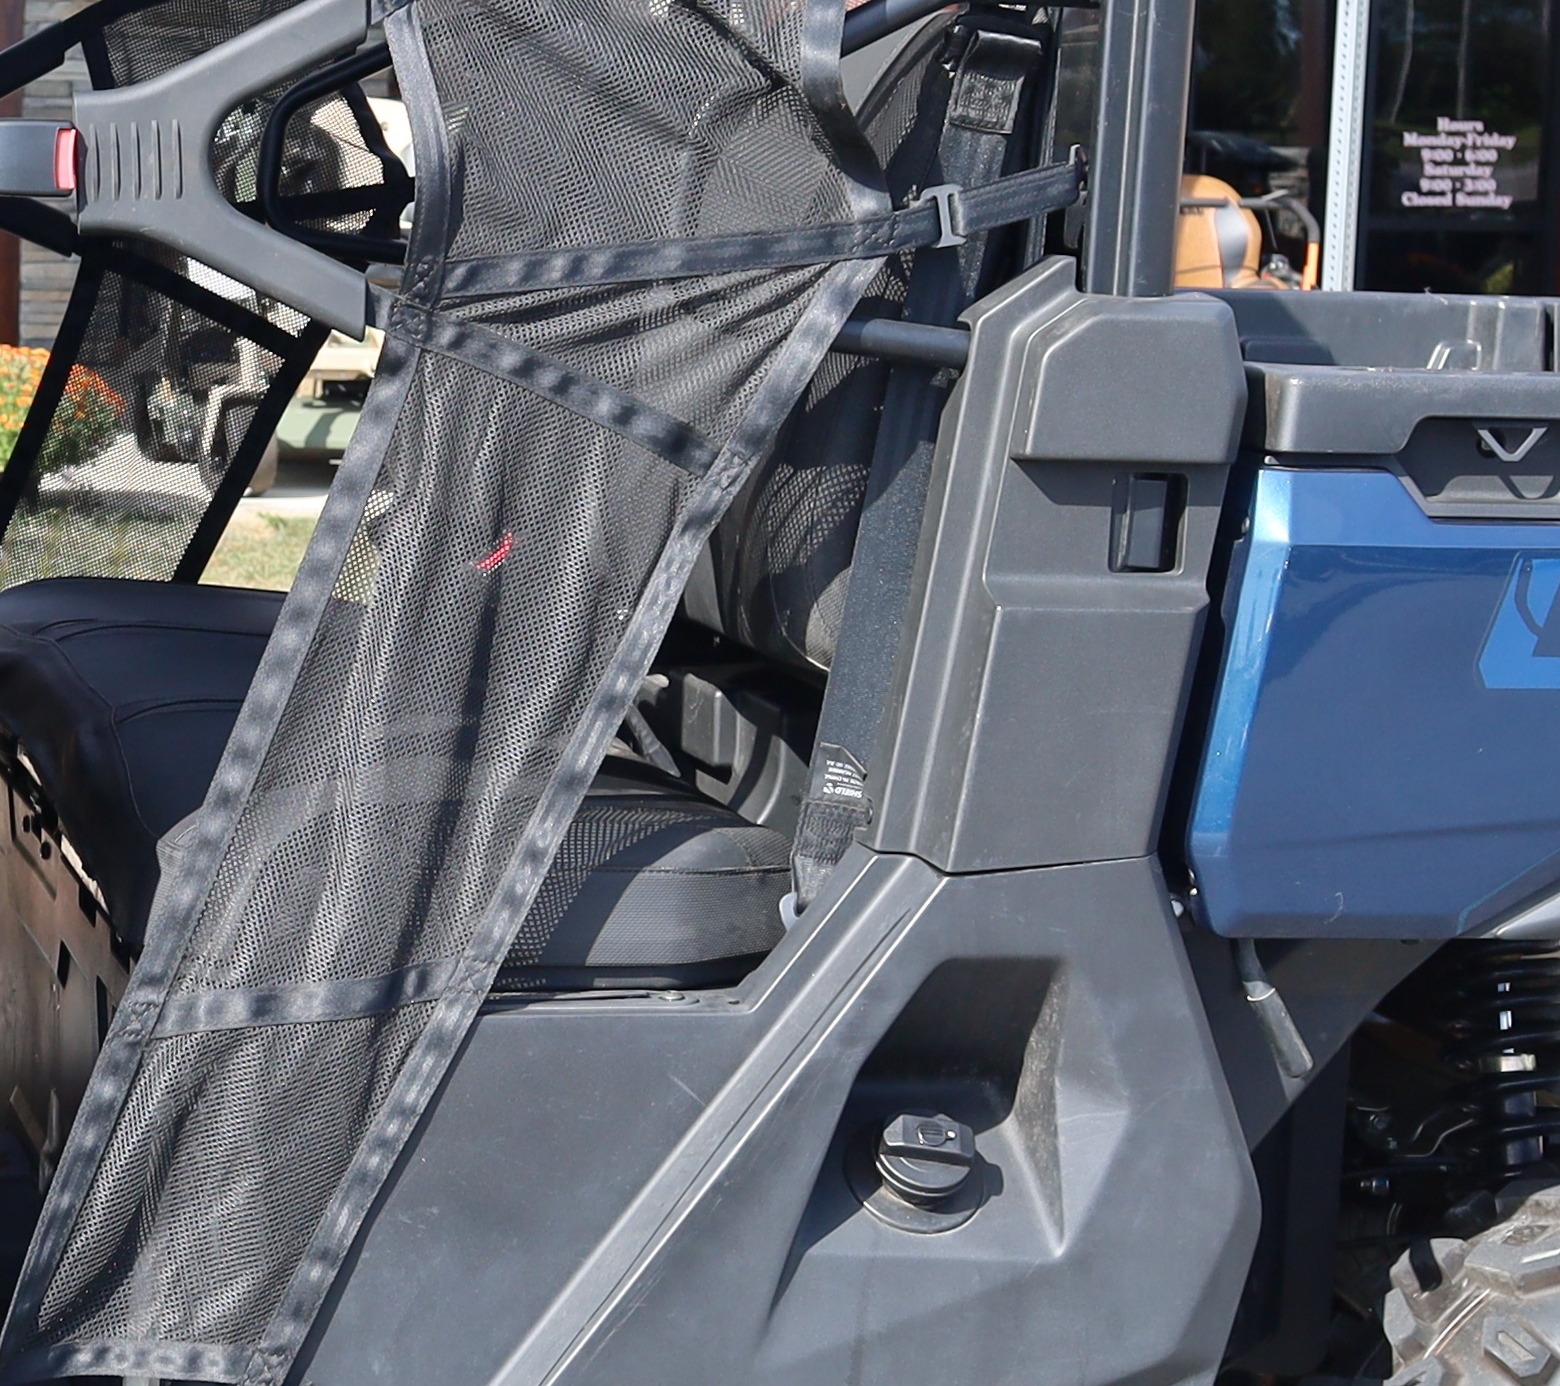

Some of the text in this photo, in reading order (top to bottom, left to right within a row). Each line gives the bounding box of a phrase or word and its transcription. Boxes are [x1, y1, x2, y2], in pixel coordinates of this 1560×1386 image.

[1436, 116, 1484, 132] Hours
[1402, 131, 1518, 150] Monday-Friday
[1423, 162, 1495, 179] Saturday
[1401, 191, 1514, 210] Closed Sunday
